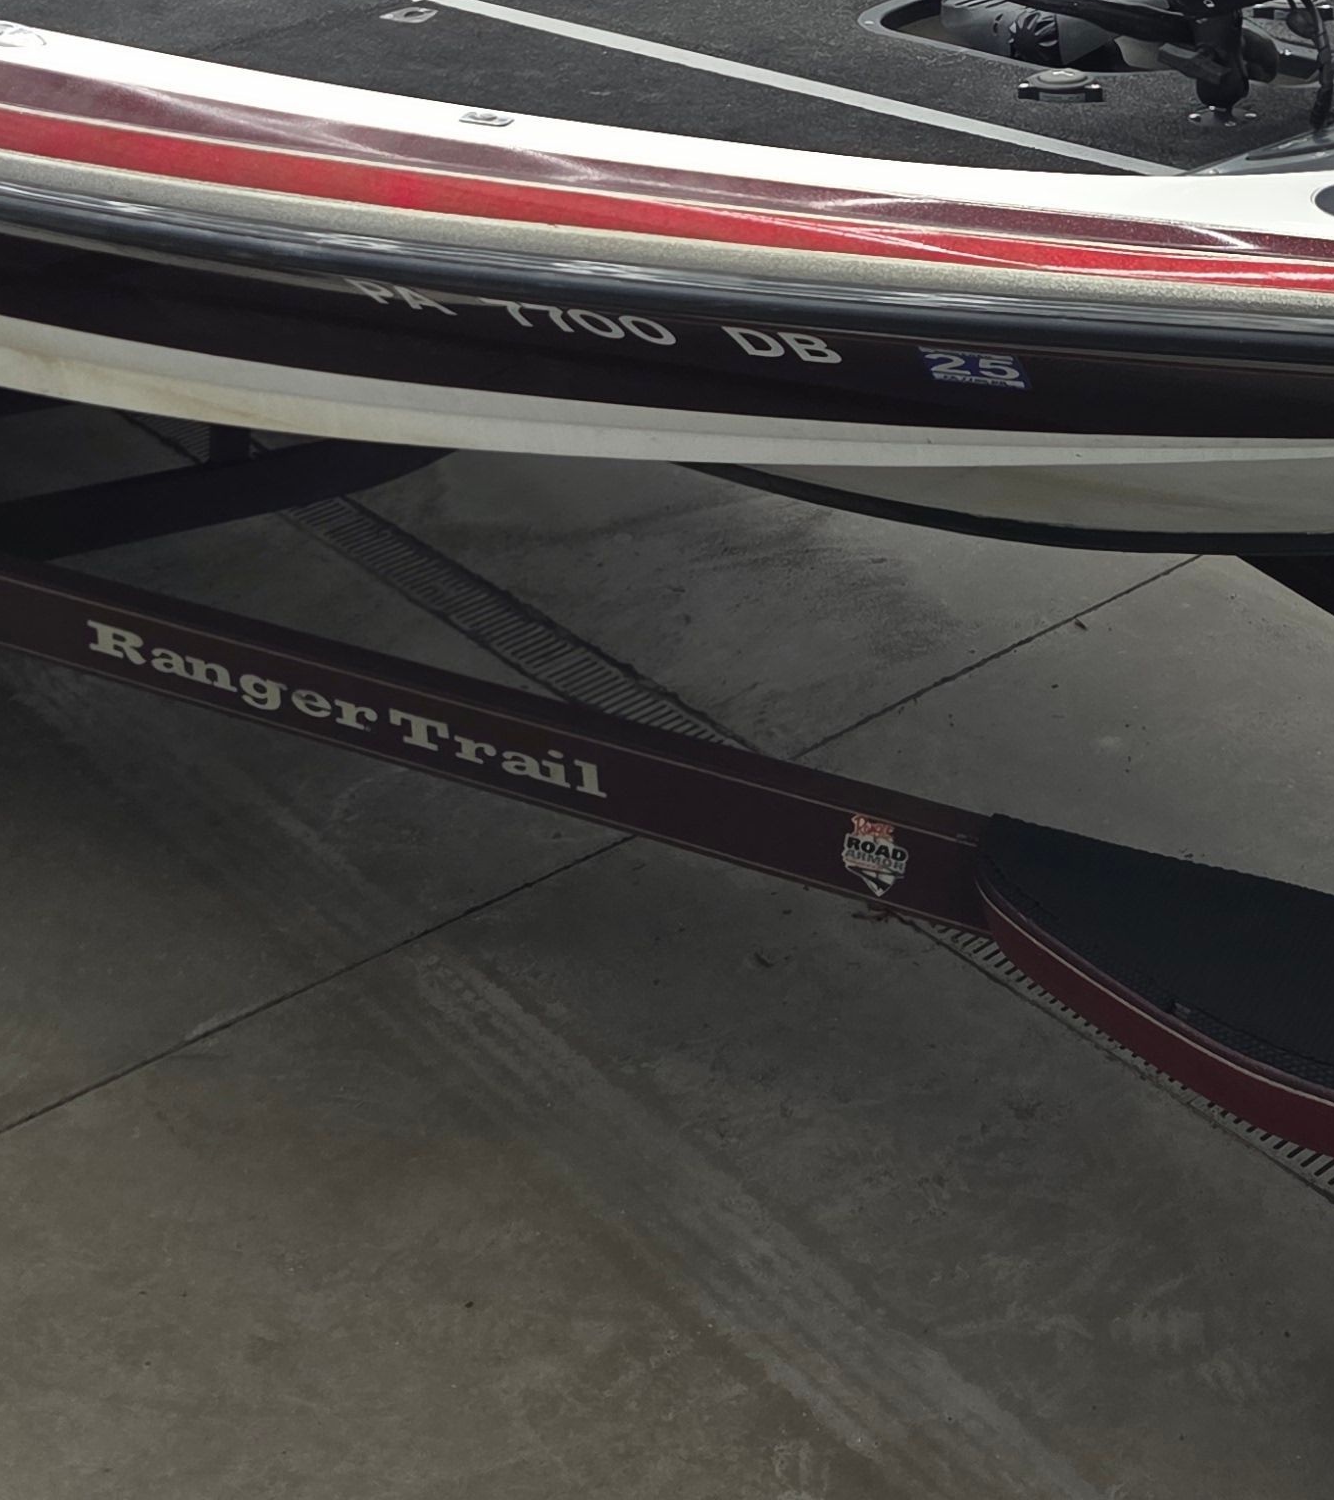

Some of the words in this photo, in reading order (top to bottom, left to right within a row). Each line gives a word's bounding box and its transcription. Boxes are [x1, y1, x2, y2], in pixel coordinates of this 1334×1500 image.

[344, 277, 457, 316] PA
[479, 297, 676, 345] 7700
[721, 326, 843, 364] DB
[925, 353, 1020, 380] 25
[87, 619, 378, 732] Ranger
[388, 708, 608, 799] Trail
[846, 836, 907, 862] ROAD
